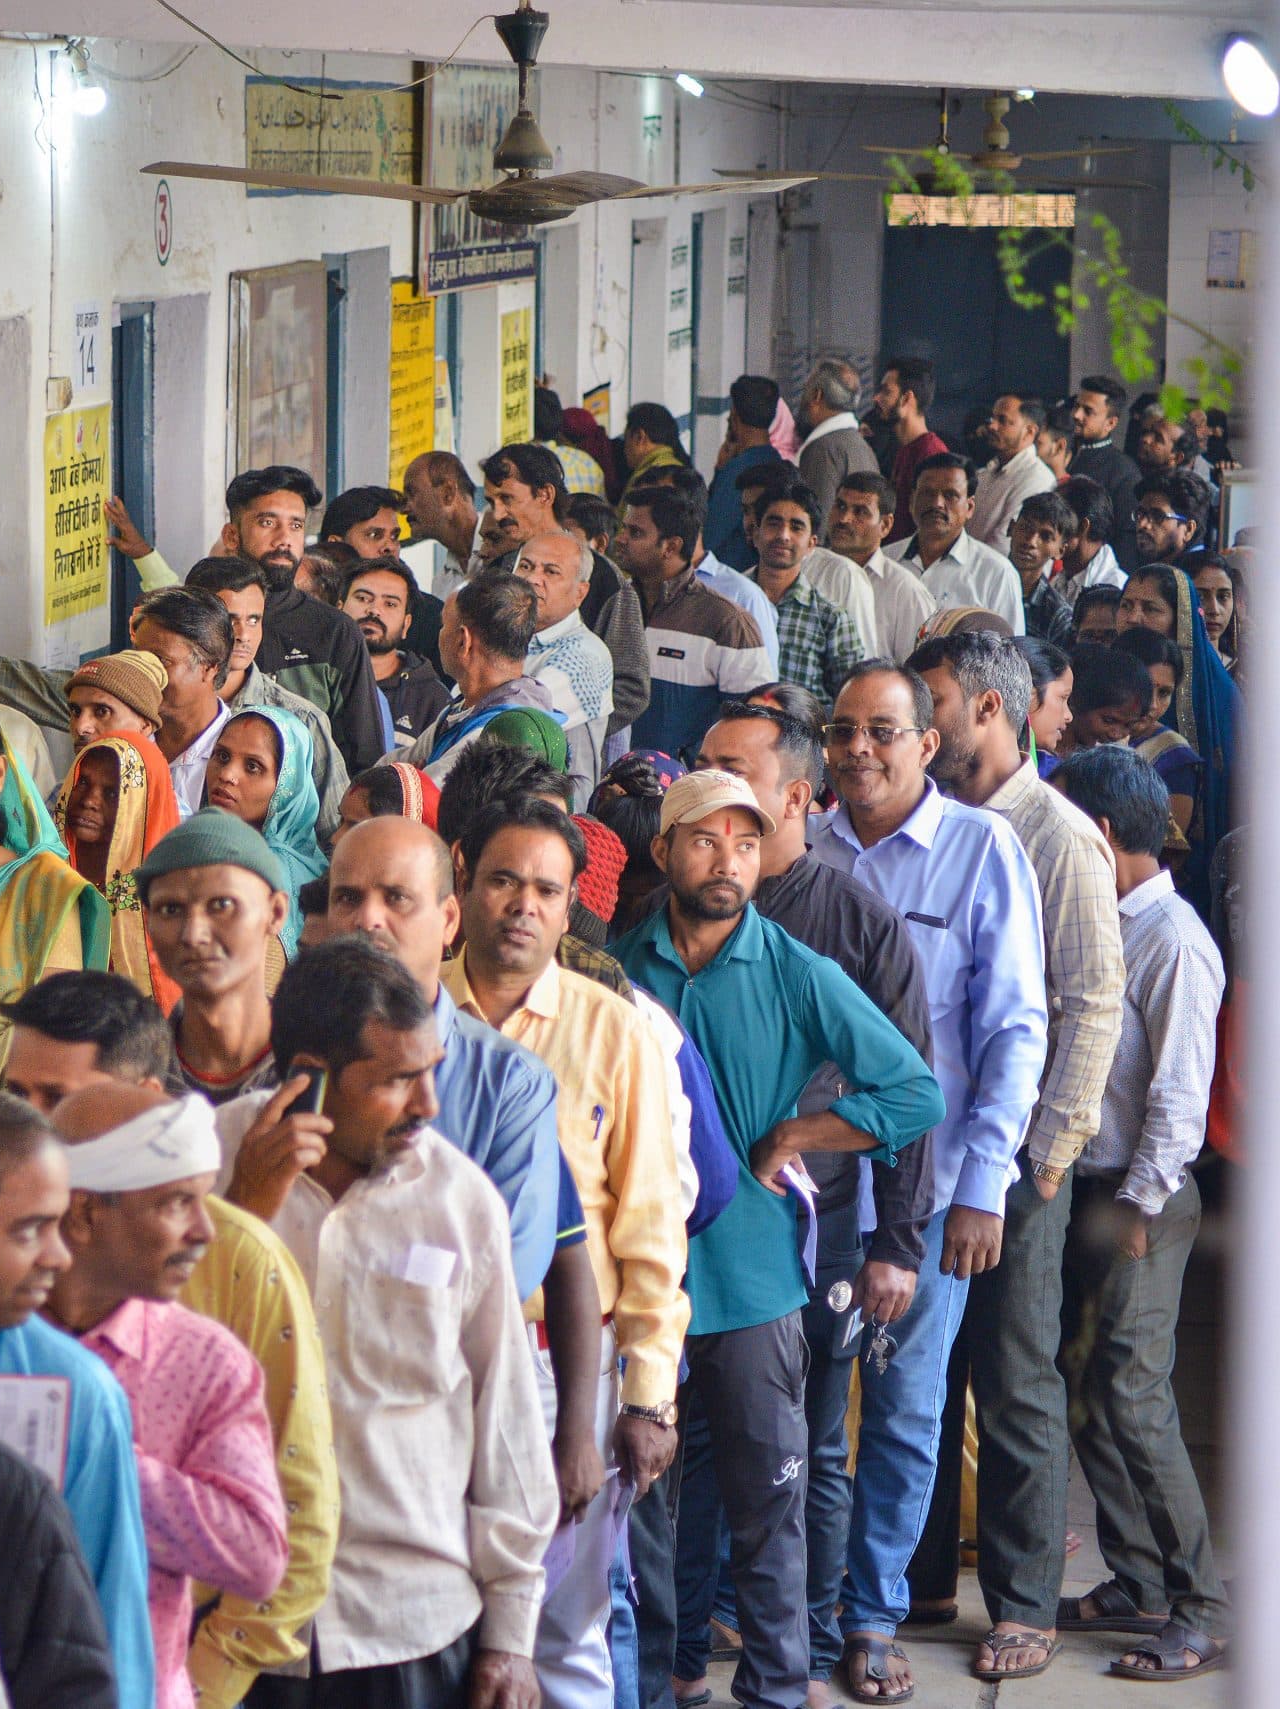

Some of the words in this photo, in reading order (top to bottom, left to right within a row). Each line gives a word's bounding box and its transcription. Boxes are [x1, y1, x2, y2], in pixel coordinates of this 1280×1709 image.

[80, 334, 95, 386] 14
[49, 464, 67, 495] आप
[91, 492, 101, 525] की
